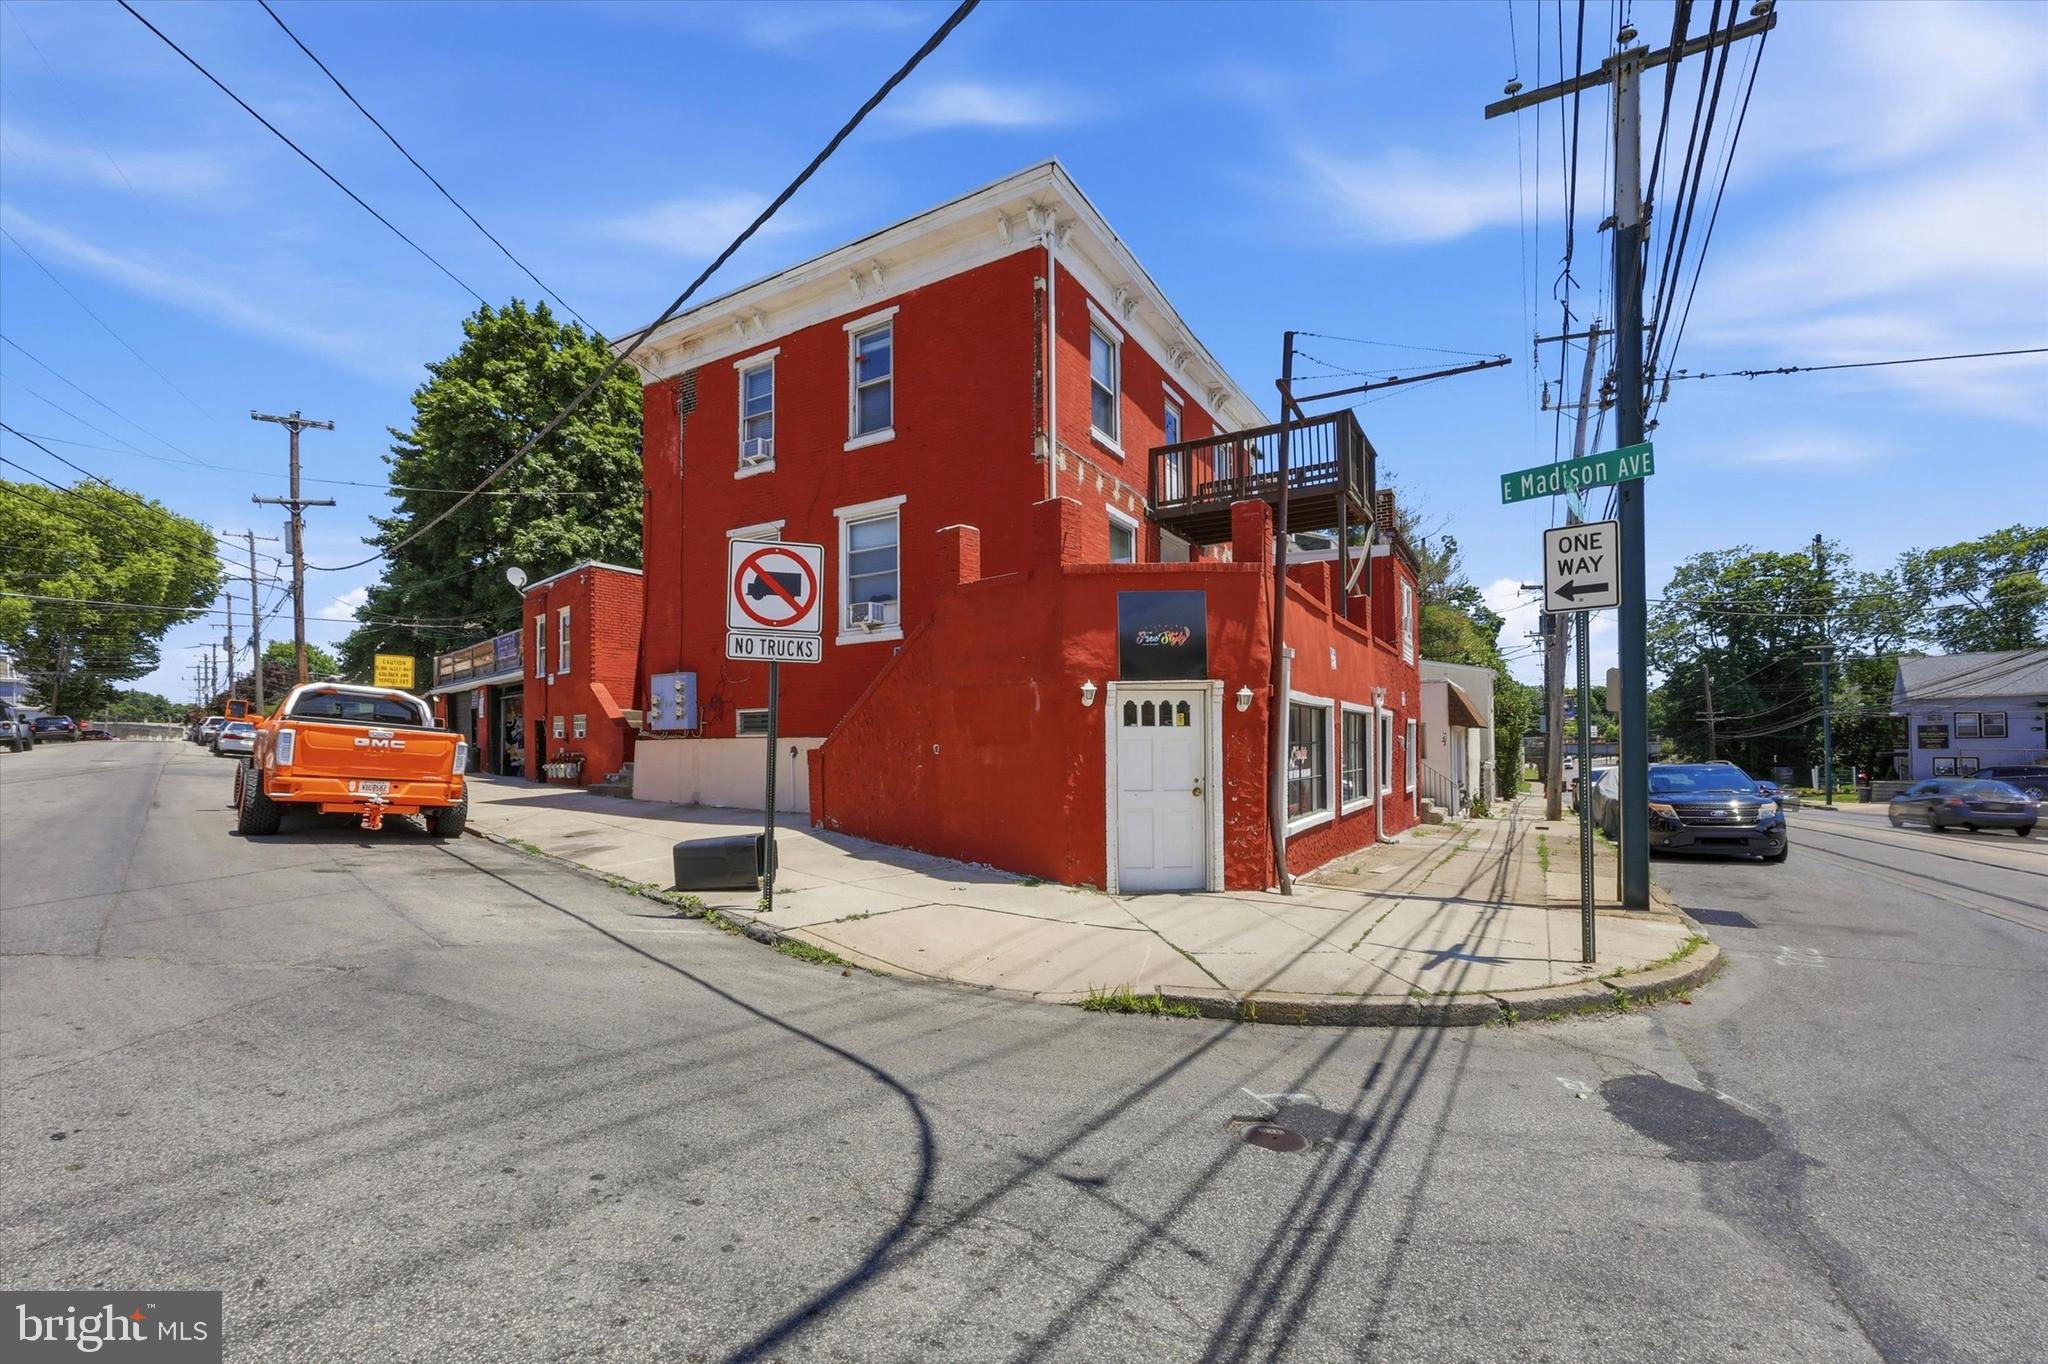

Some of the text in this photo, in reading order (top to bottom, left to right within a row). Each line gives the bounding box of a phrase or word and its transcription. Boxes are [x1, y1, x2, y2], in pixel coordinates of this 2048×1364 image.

[1504, 452, 1652, 500] E Madison AVE
[1558, 532, 1602, 554] ONE
[1557, 555, 1604, 577] WAY
[735, 637, 813, 658] NO TRUCKS
[354, 738, 406, 749] GMC
